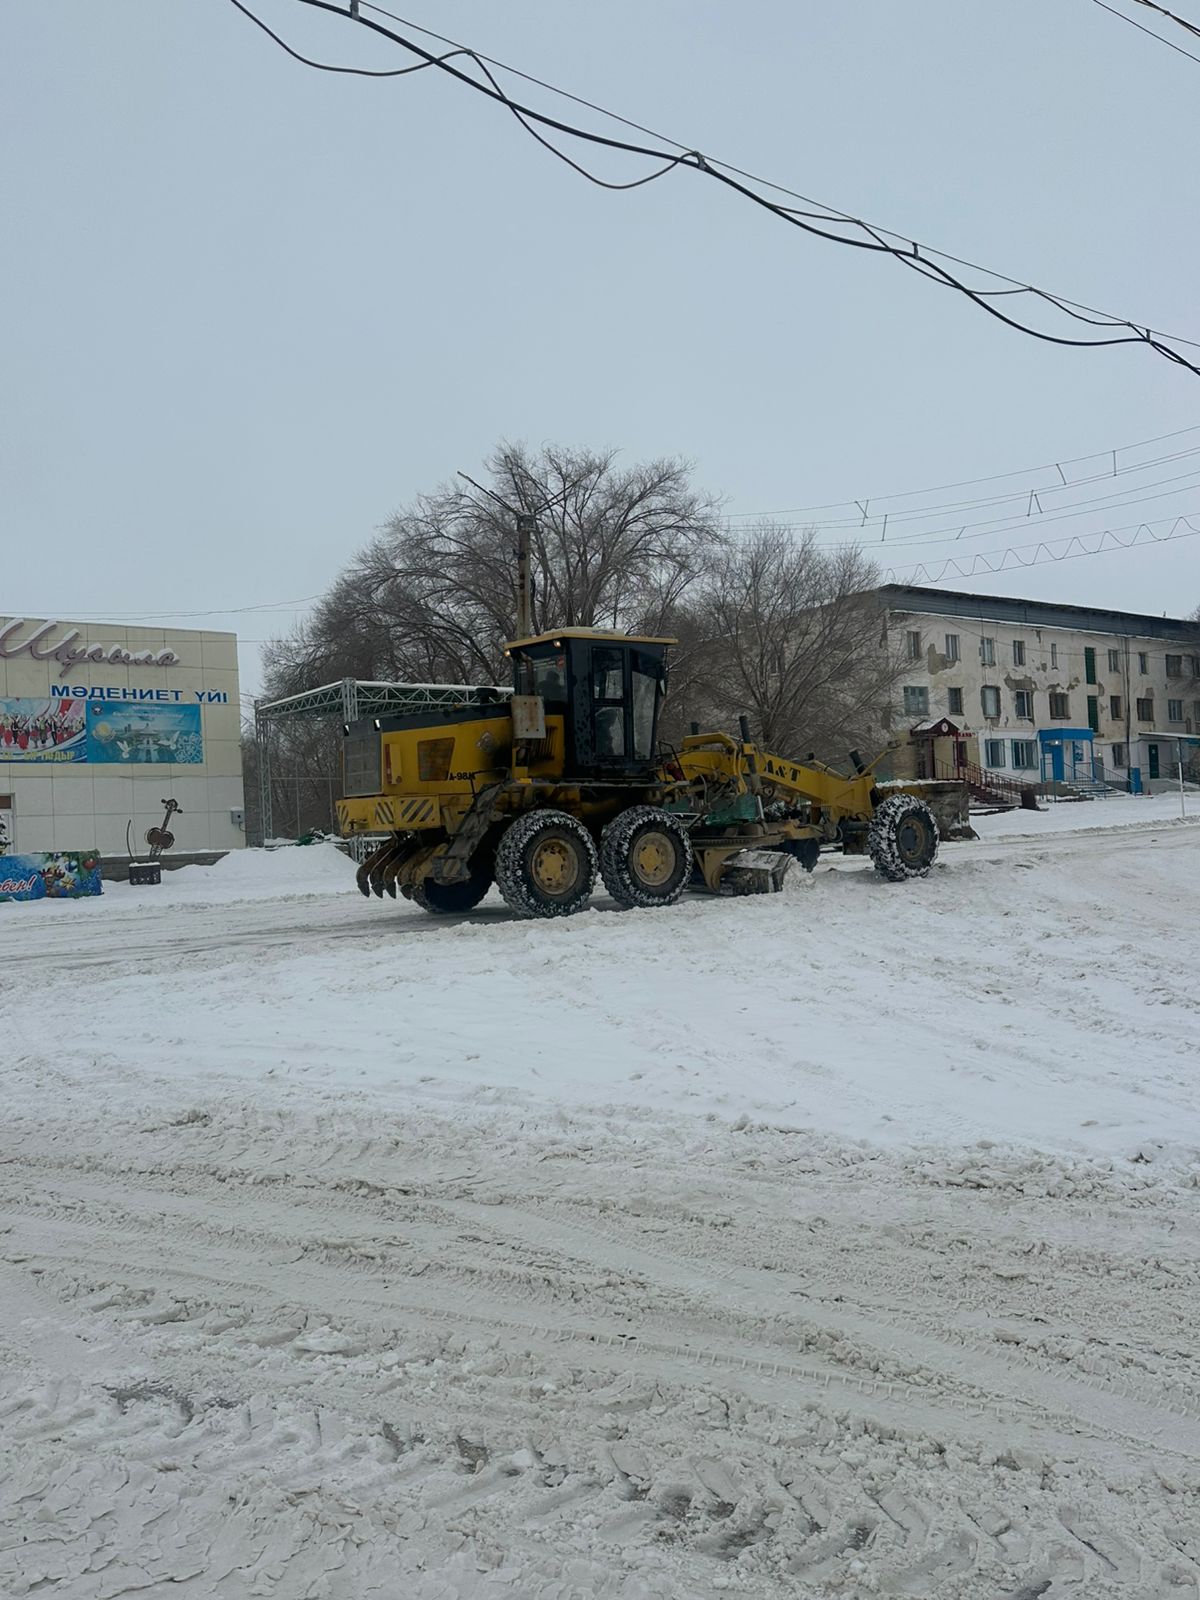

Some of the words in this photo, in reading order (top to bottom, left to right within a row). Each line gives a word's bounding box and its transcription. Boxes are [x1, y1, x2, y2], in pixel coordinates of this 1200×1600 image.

[51, 685, 184, 701] МӘДЕНИЕТ
[195, 689, 228, 703] ҮЙІ
[0, 874, 38, 893] бен!
